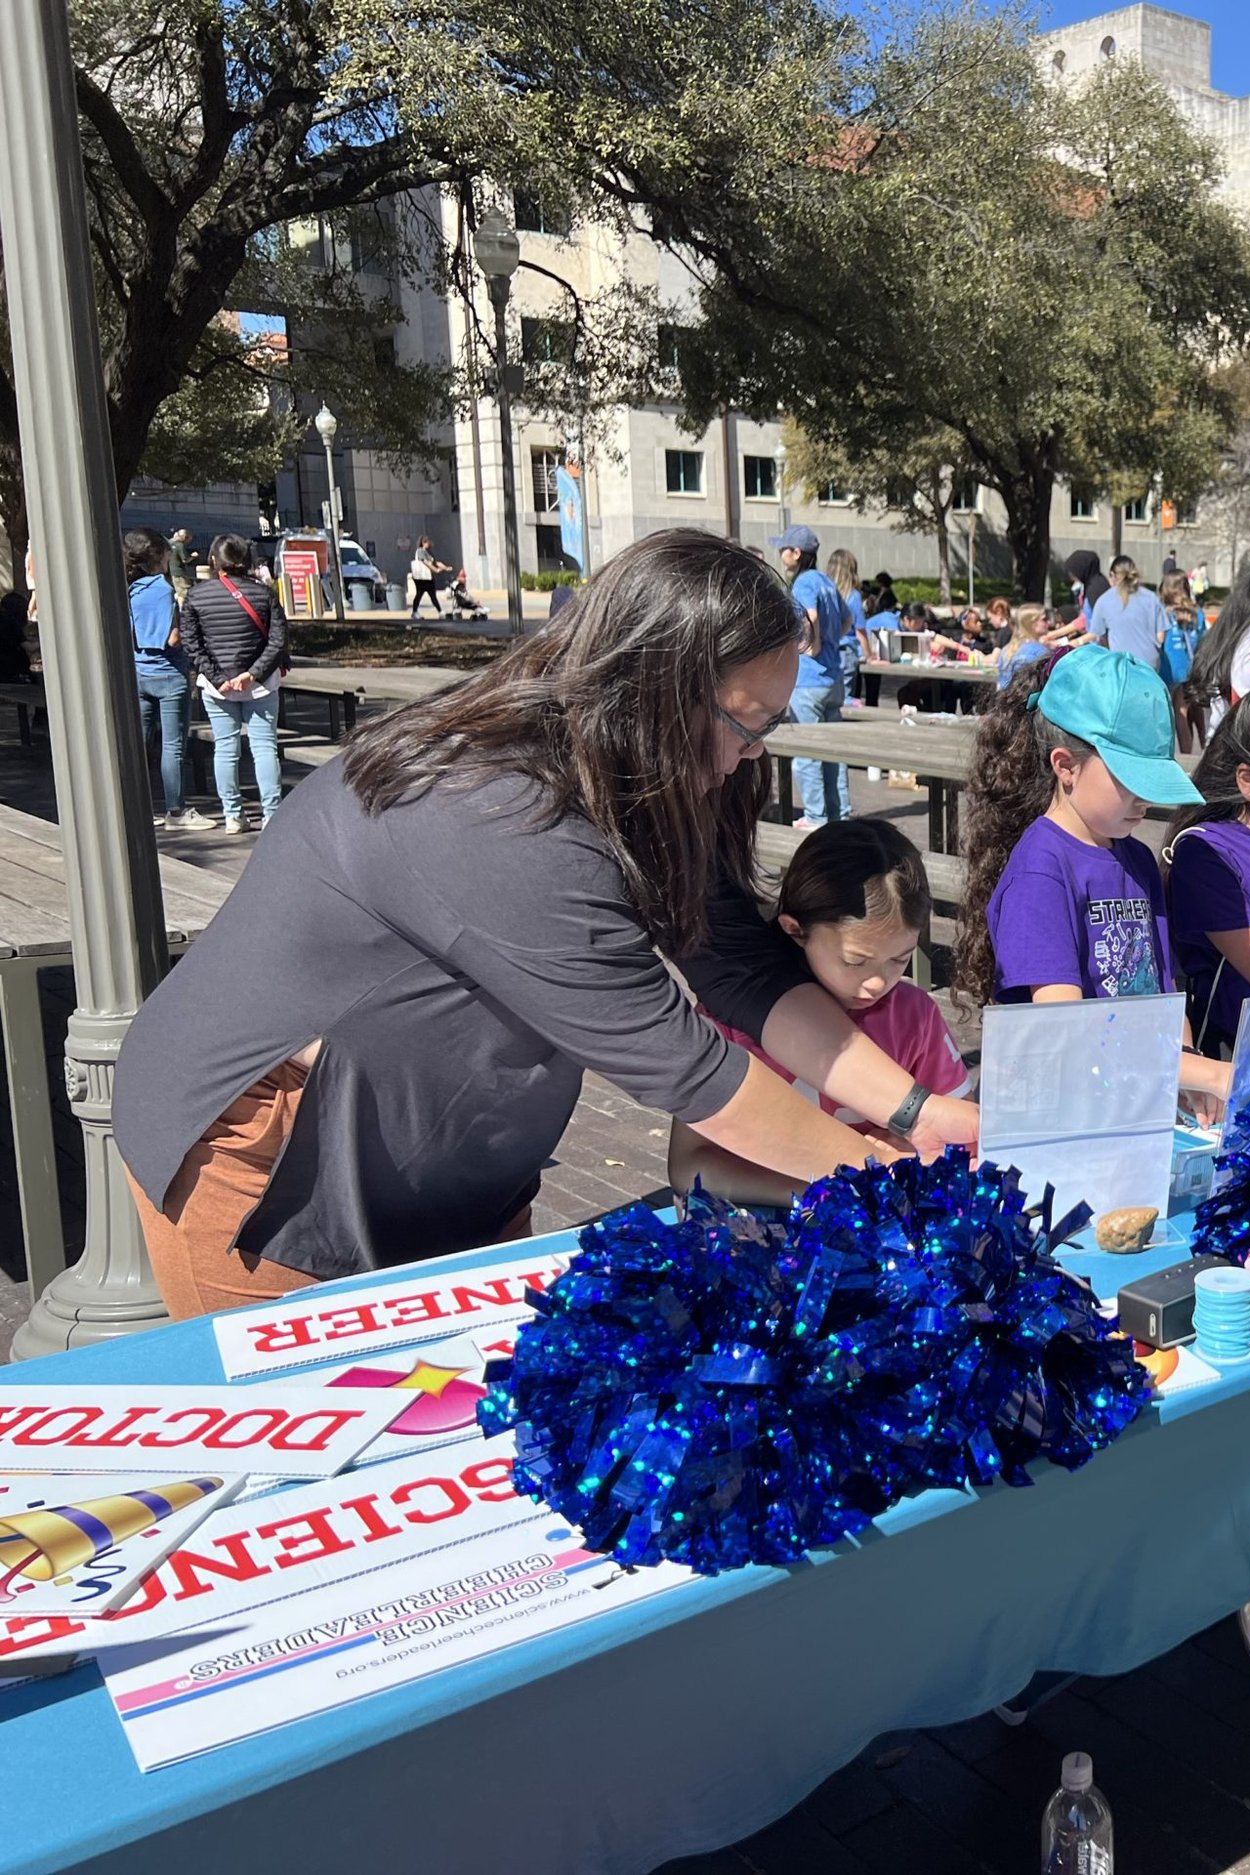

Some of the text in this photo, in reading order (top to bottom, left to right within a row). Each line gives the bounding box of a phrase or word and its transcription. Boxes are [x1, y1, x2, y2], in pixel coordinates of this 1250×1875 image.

[190, 1553, 554, 1682] CHEERLEADERS
[335, 1586, 592, 1680] www.sciencecheerleaders.org
[376, 1570, 569, 1646] SCIENCE
